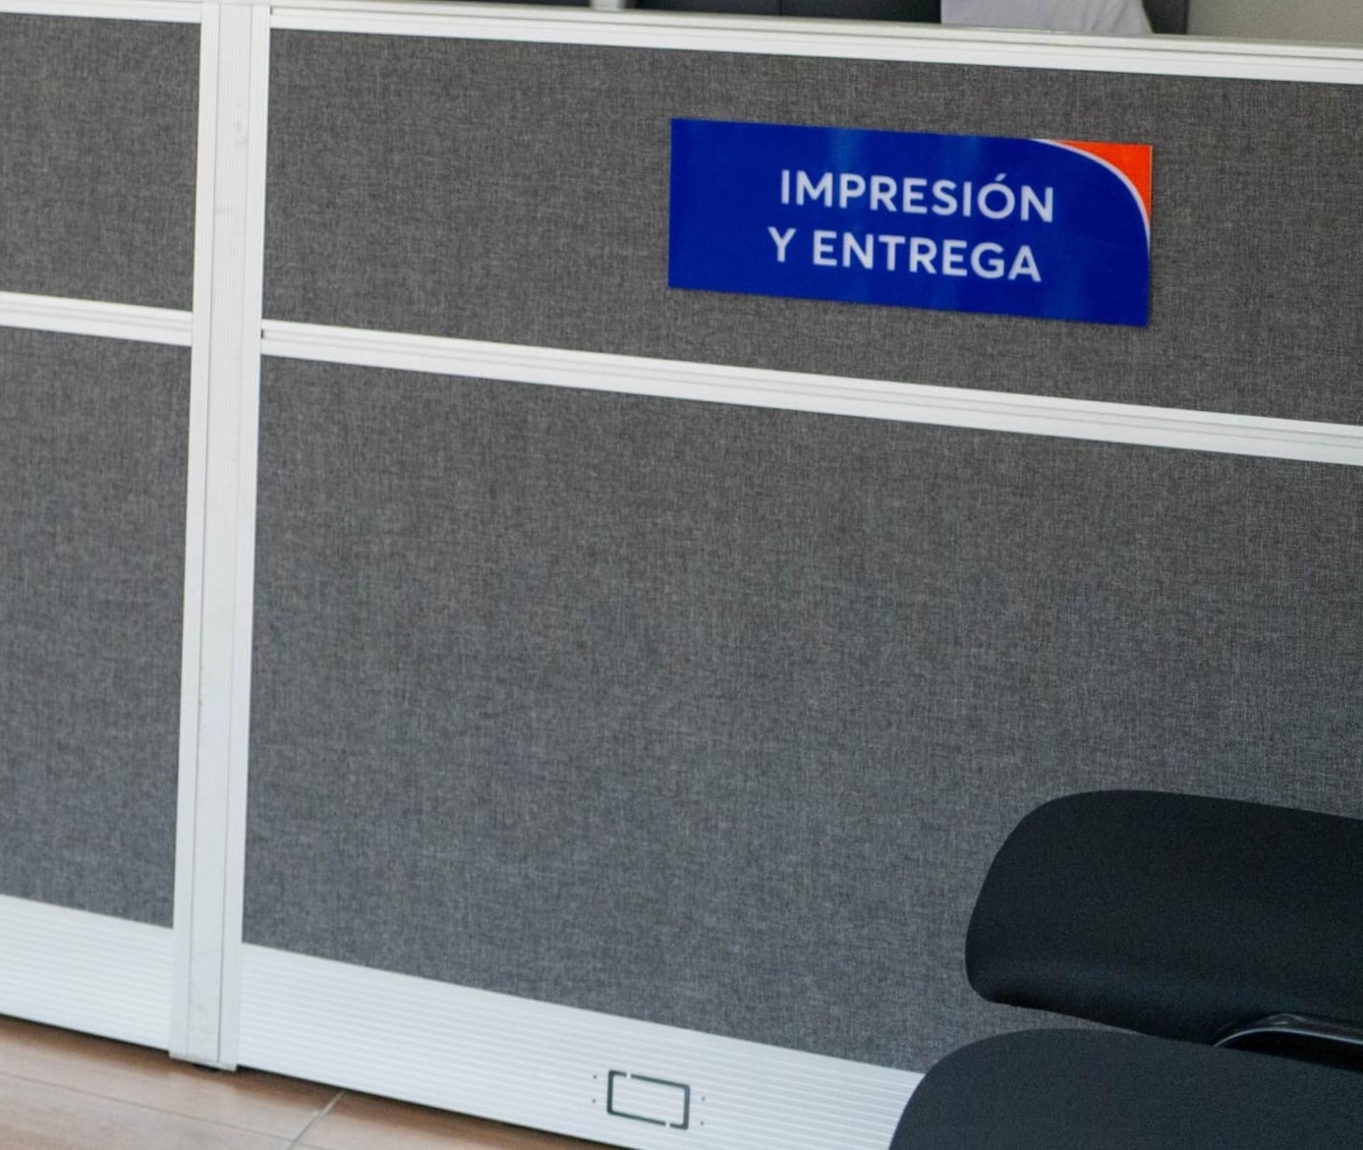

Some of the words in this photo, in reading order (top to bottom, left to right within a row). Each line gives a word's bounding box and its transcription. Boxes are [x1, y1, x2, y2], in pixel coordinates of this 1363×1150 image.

[781, 169, 1054, 223] IMPRESIÓN
[767, 226, 797, 263] Y
[812, 229, 1042, 283] ENTREGA
